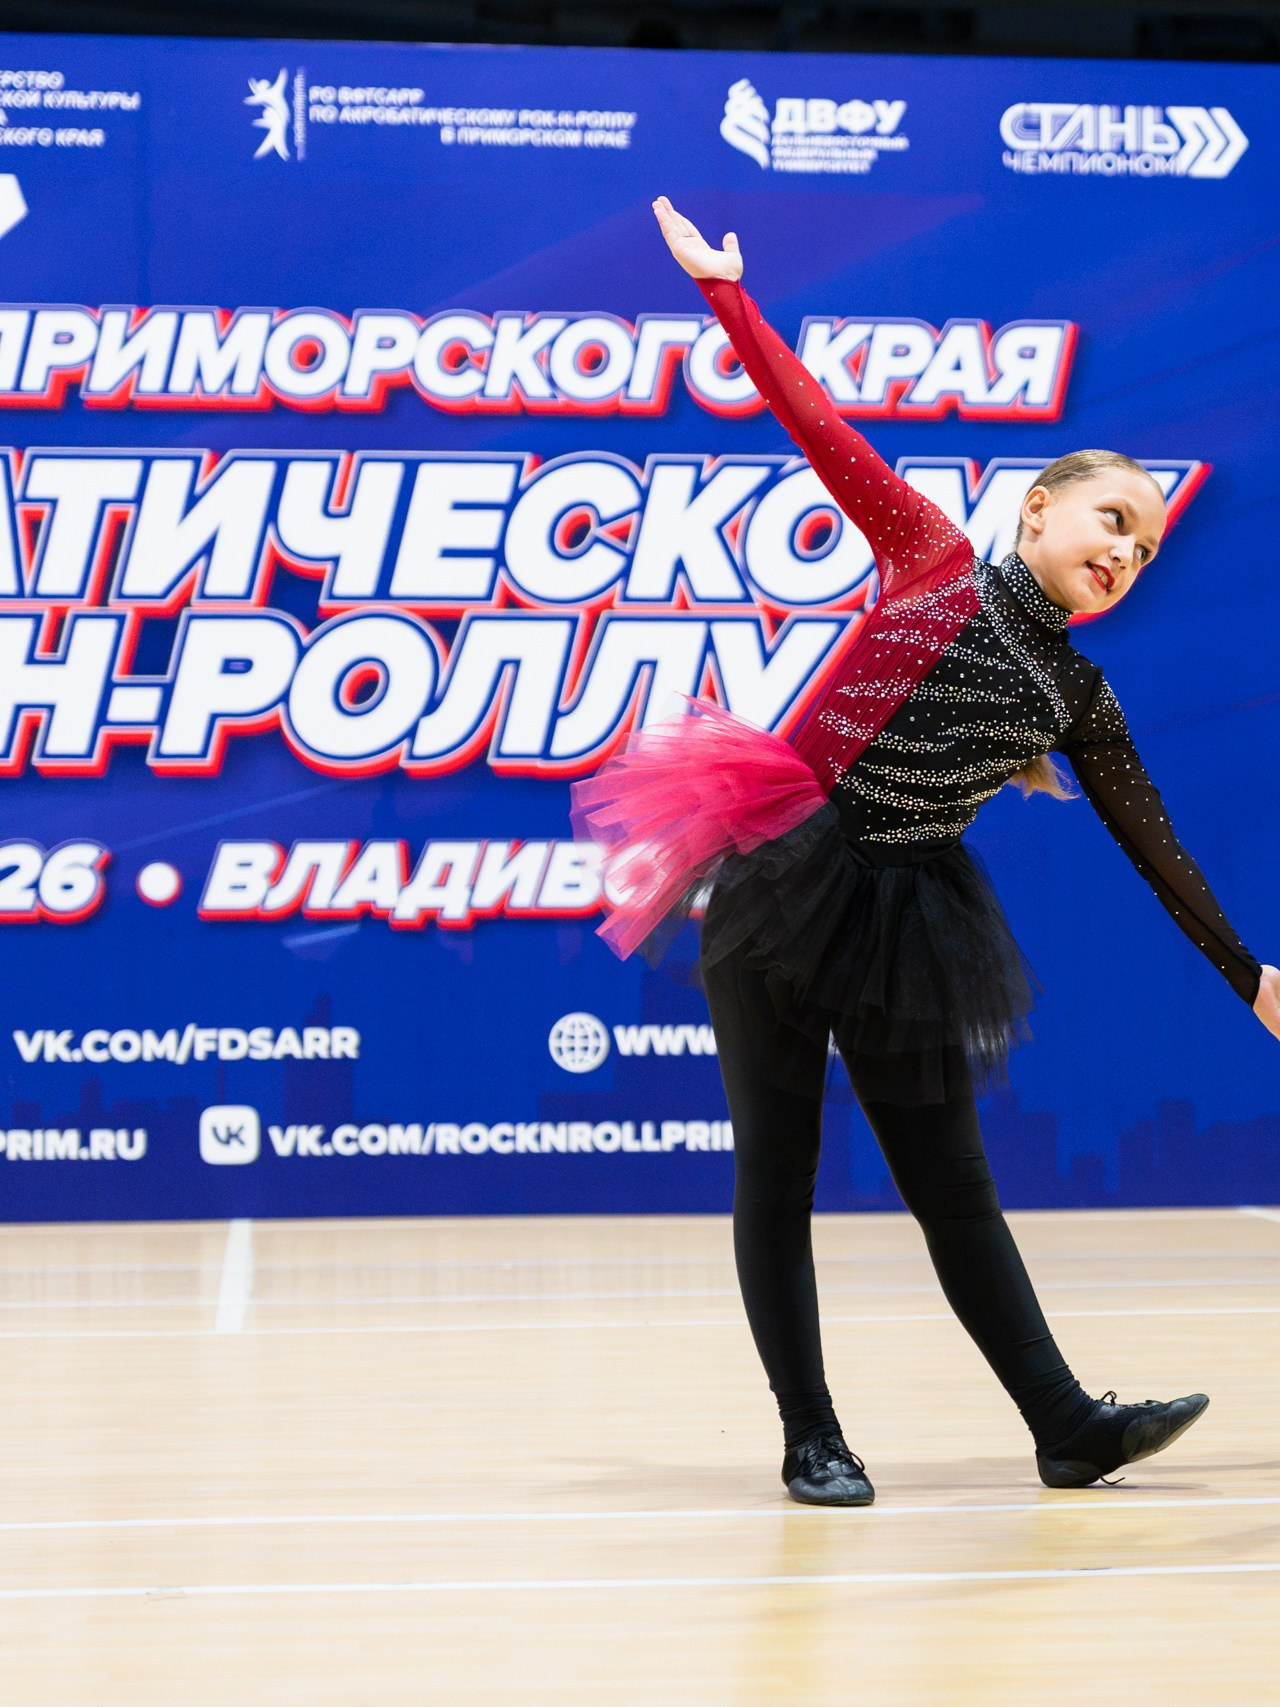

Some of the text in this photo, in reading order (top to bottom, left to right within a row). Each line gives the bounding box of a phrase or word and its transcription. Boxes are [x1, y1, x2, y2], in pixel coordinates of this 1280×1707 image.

[0, 70, 65, 90] РСТВО
[43, 90, 141, 111] КУЛЬТУРЫ
[309, 86, 337, 105] РО
[309, 105, 338, 124] ПО
[339, 106, 518, 128] АКРОБАТИЧЕСКОМУ
[771, 97, 908, 136] ДВФУ
[999, 102, 1181, 154] СТАНЬ
[0, 127, 105, 148] КОГО КРАЯ
[440, 127, 631, 150] В ПРИМОРСКОМ КРАЕ
[1002, 150, 1188, 178] ЧЕМПИОНОМ
[795, 315, 1079, 421] КРАЯ
[198, 838, 716, 930] ВЛАДИВО
[13, 1022, 361, 1065] VK.COM/FDSARR
[0, 1128, 148, 1161] RIM.RU
